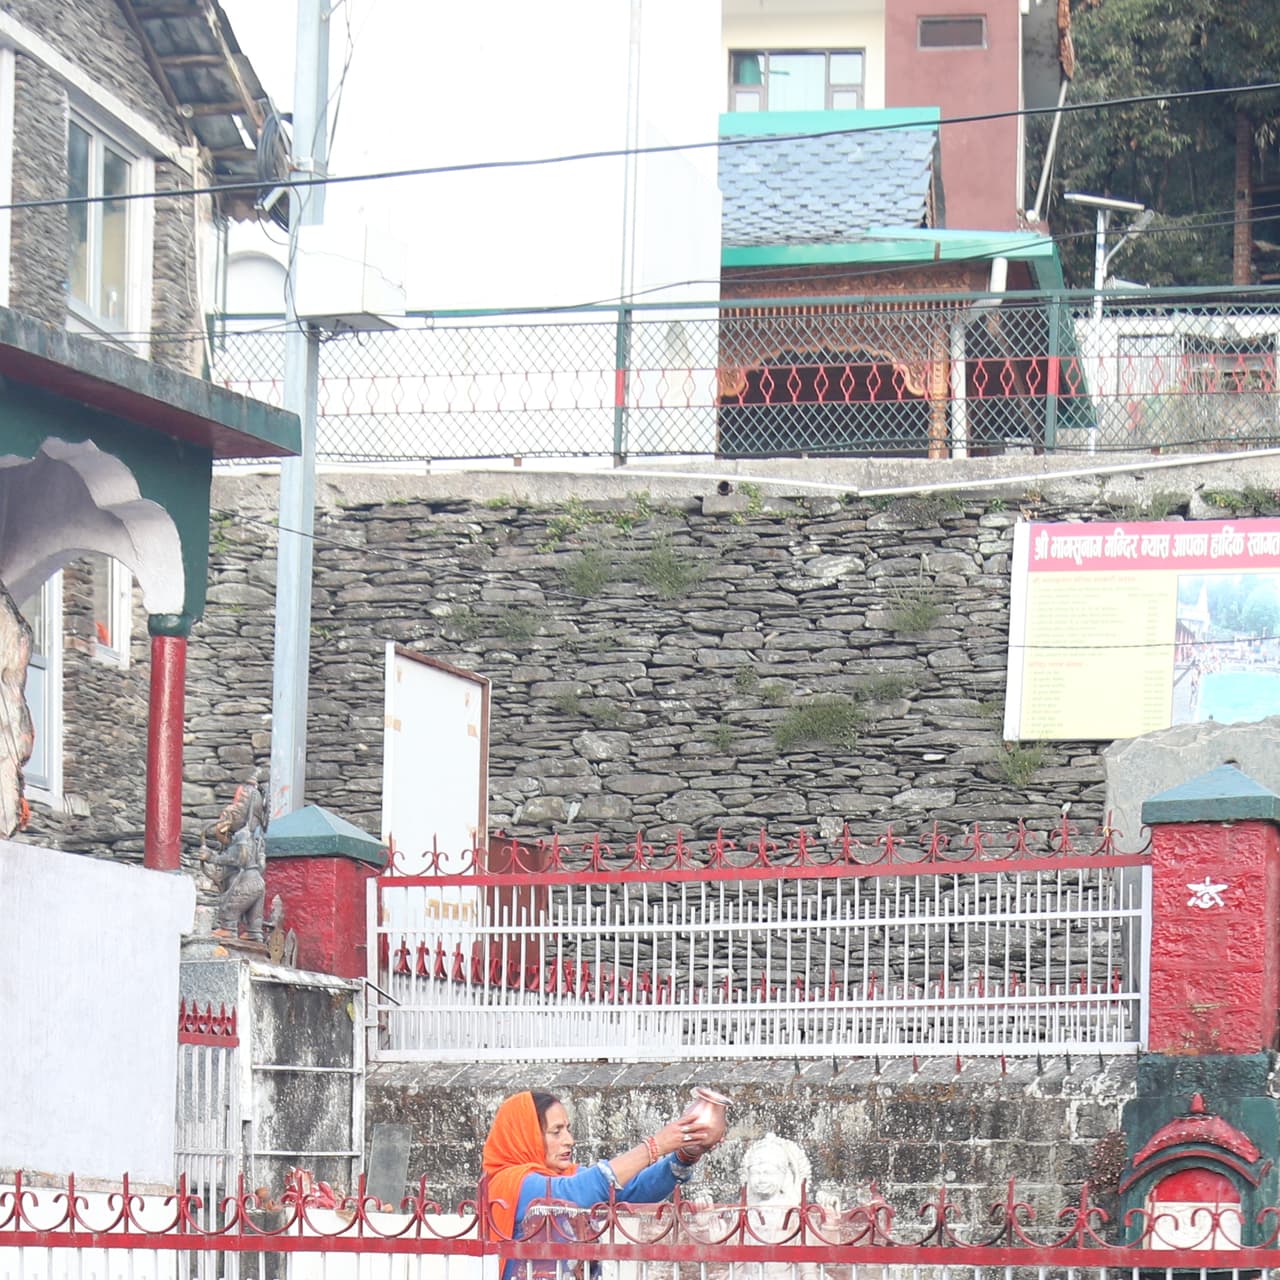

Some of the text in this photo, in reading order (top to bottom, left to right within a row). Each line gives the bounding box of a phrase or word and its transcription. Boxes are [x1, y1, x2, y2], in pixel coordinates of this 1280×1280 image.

[1034, 529, 1050, 560] श्री
[1104, 527, 1139, 559] मन्दिर
[1140, 534, 1171, 559] न्यास
[1172, 533, 1209, 558] आपका
[1209, 525, 1245, 559] हार्दिक
